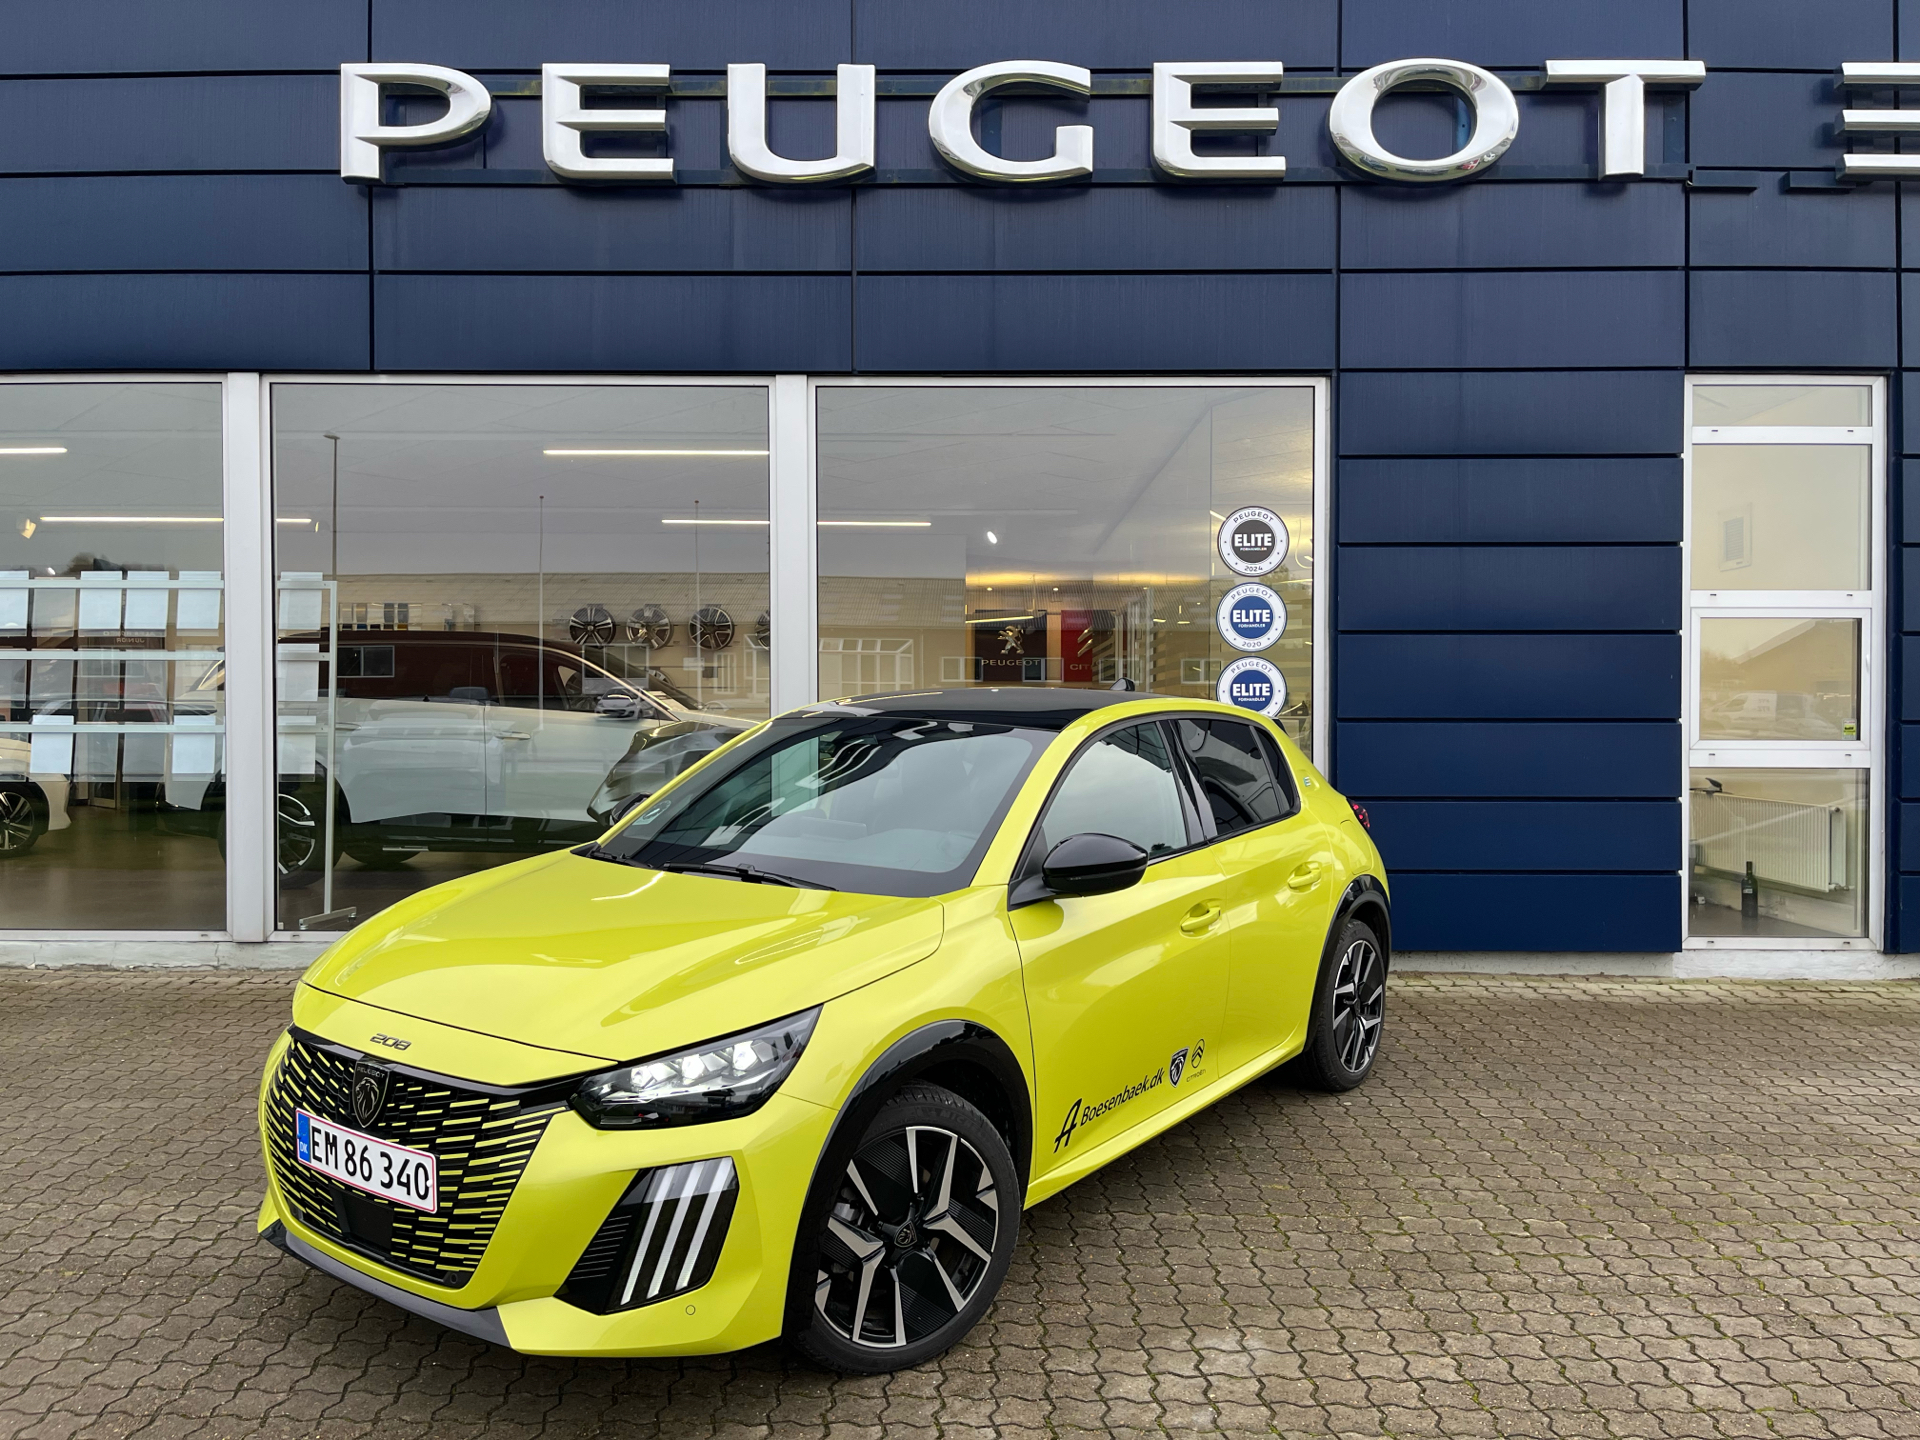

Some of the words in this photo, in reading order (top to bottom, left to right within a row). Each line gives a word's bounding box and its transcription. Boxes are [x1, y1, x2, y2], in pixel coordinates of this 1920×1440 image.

[340, 57, 1706, 184] PEUGEOT
[1232, 510, 1274, 523] PEUGEOT
[1234, 533, 1272, 547] ELITE
[1230, 587, 1273, 599] PEUGEOT
[1232, 609, 1271, 622] ELITE
[981, 659, 1041, 667] PEUGEOT
[1230, 660, 1273, 673] PEUGEOT
[1232, 683, 1271, 697] ELITE
[370, 1033, 412, 1051] 208
[357, 1066, 386, 1079] PEUGEOT
[1080, 1066, 1166, 1127] Boesenbaek.dk
[300, 1141, 308, 1154] DK
[311, 1125, 338, 1170] EM
[344, 1138, 373, 1182] 86
[379, 1150, 430, 1200] 340
